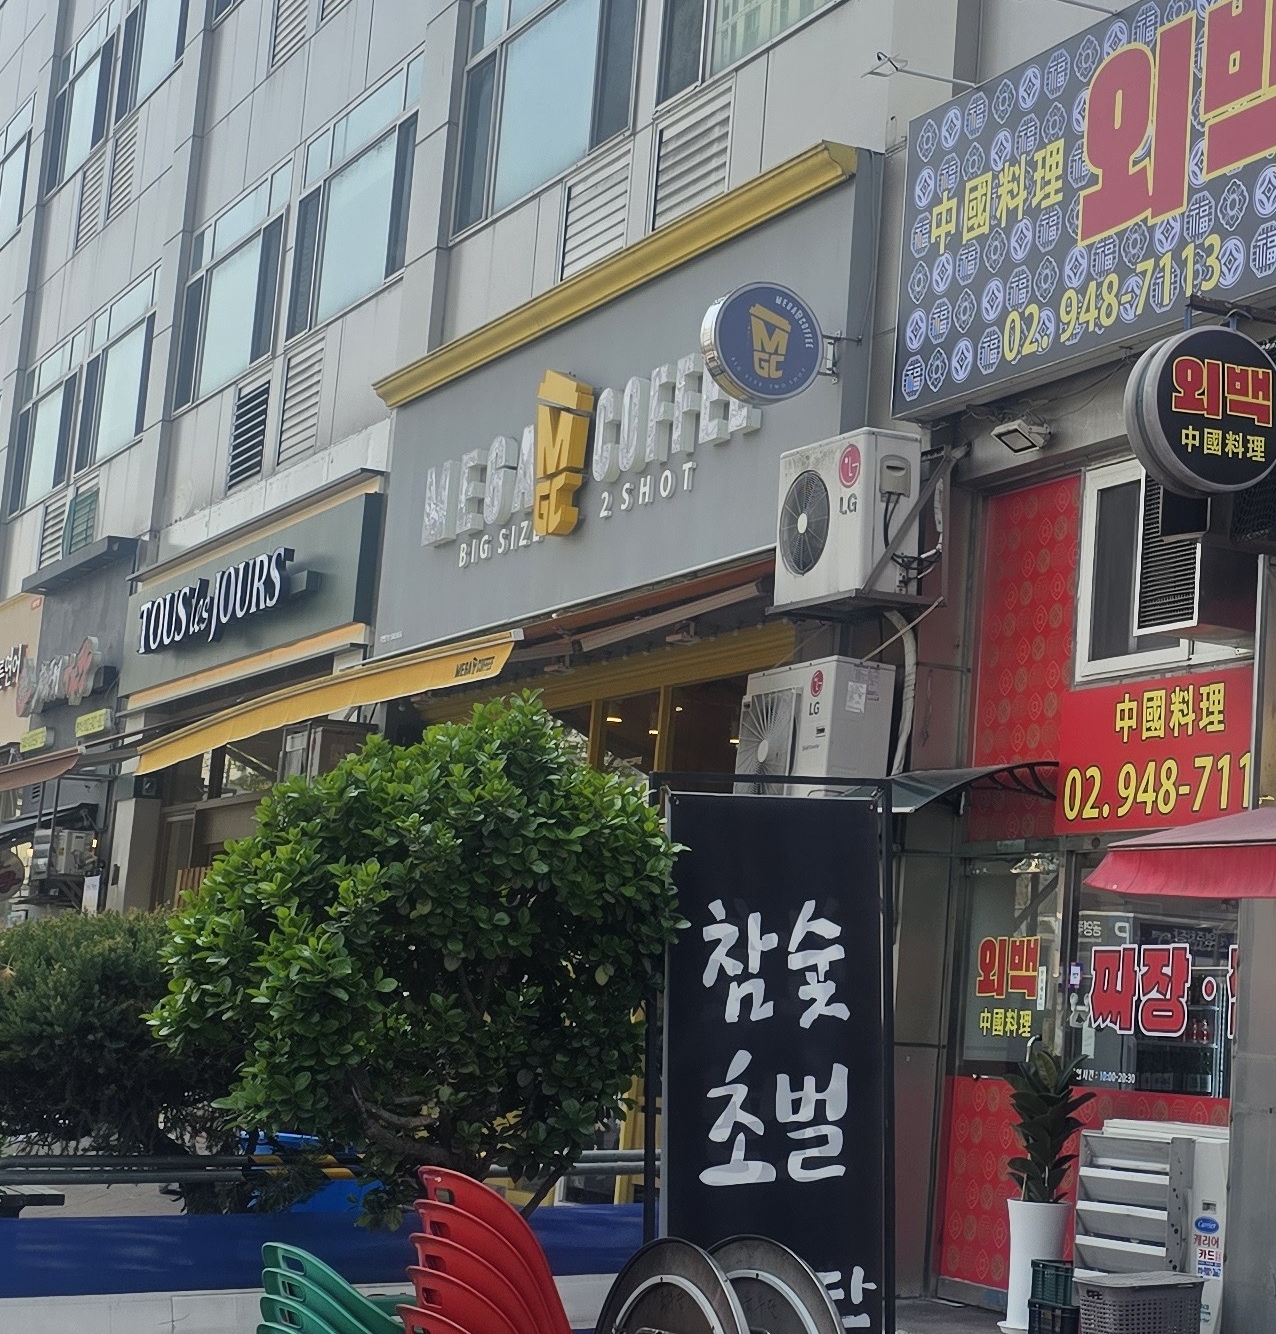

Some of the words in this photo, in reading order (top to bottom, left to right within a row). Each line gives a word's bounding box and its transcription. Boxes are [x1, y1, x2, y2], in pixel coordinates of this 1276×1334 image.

[931, 138, 1065, 255] 中國料理
[1060, 234, 1222, 343] 948-7113
[1172, 355, 1273, 428] 외백
[421, 424, 536, 547] MEGA
[1181, 425, 1266, 462] 中國料理
[458, 534, 491, 568] BIG
[599, 491, 613, 518] 2
[620, 461, 697, 510] SHOT
[839, 493, 858, 515] LG
[138, 586, 191, 655] TOUS
[189, 578, 211, 635] les
[207, 547, 288, 643] JOURS
[809, 702, 820, 716] LG
[1115, 682, 1226, 744] 中國料理
[702, 898, 851, 1029] 참숯
[976, 936, 1041, 1000] 외백
[980, 1007, 1032, 1037] 中國料理
[699, 1048, 849, 1187] 초벌
